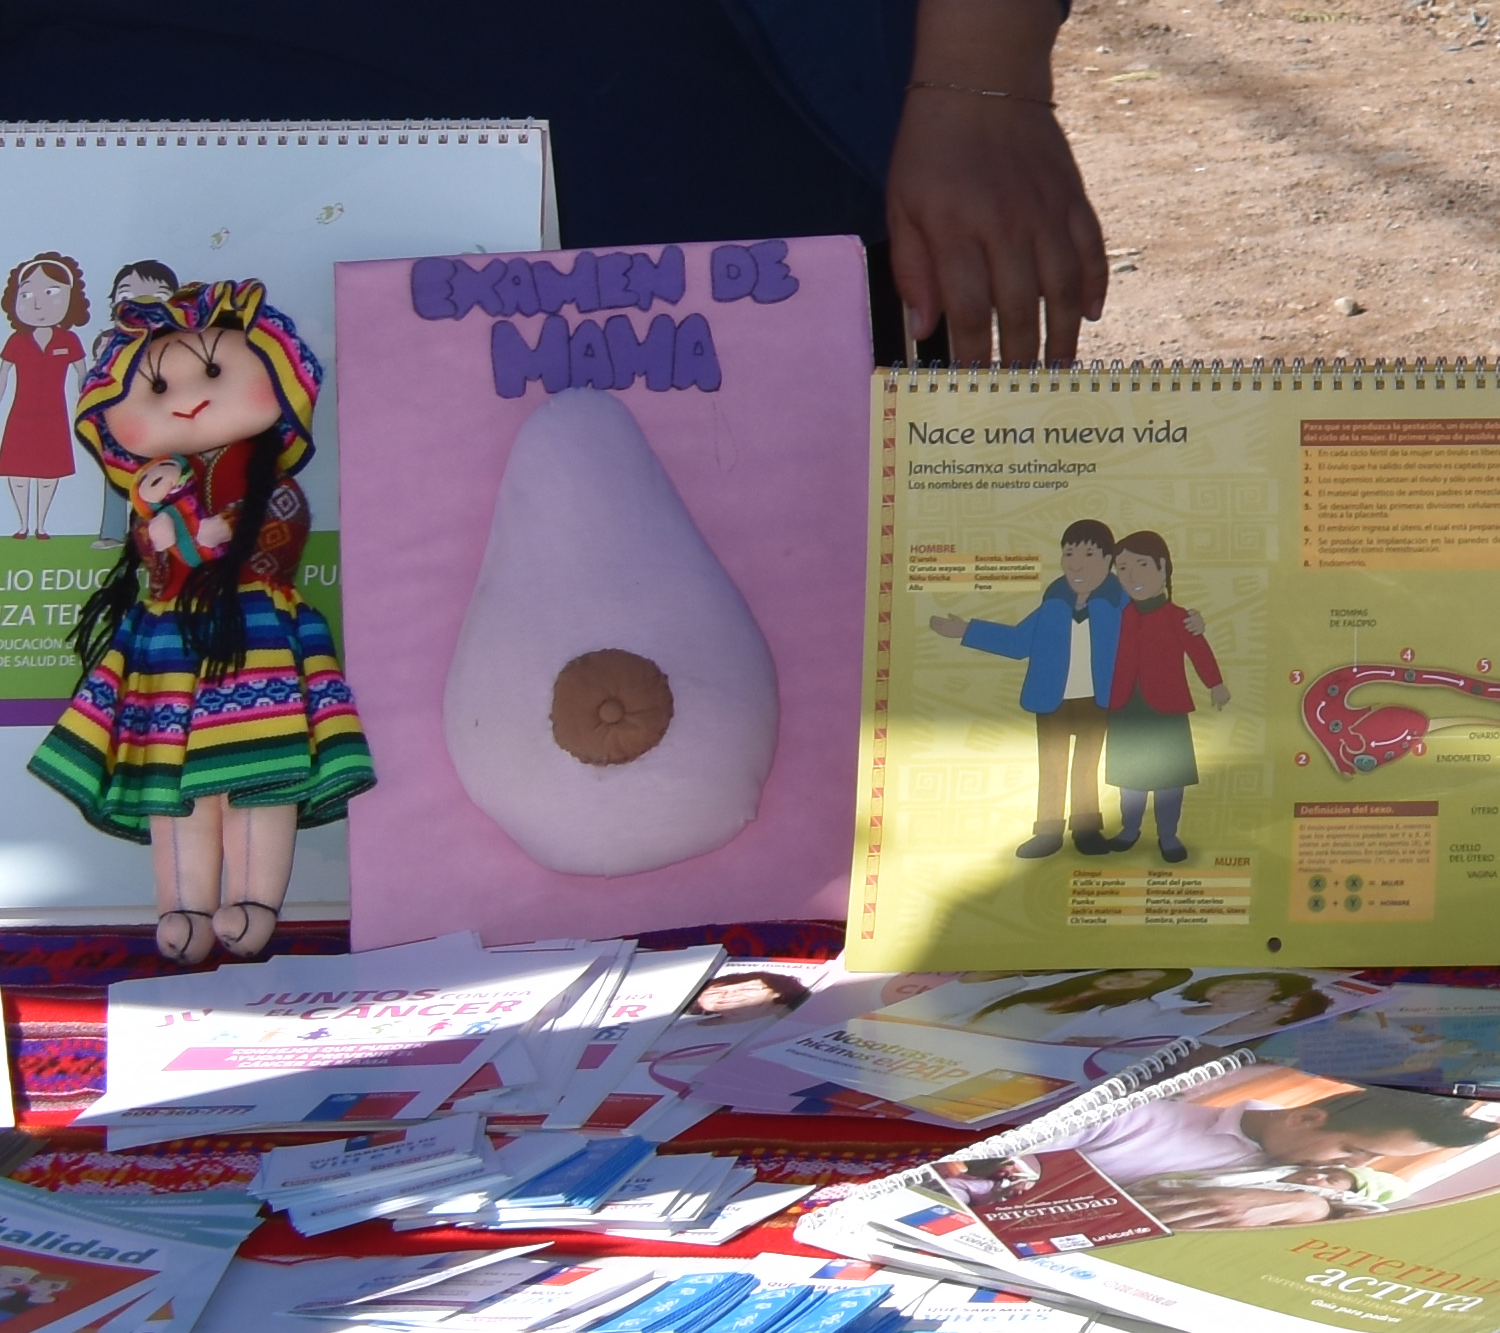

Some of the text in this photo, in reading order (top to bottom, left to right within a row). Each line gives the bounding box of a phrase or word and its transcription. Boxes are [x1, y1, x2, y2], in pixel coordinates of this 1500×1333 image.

[410, 239, 800, 321] EXAMEN DE
[490, 313, 723, 400] MAMA
[908, 419, 1188, 445] Nace una nueva vida
[1008, 459, 1097, 476] sutinakapa
[908, 479, 1069, 491] Los nombres de nuestro cuerpo
[910, 545, 956, 554] HOMBRE
[1300, 805, 1395, 815] Definición del sexo.
[1214, 856, 1251, 867] MUJER
[245, 987, 441, 1007] JUNTOS
[300, 999, 522, 1021] CÁNCER
[796, 1037, 876, 1061] hicimos
[824, 1030, 929, 1060] Nosotras
[1311, 1298, 1338, 1310] Guía
